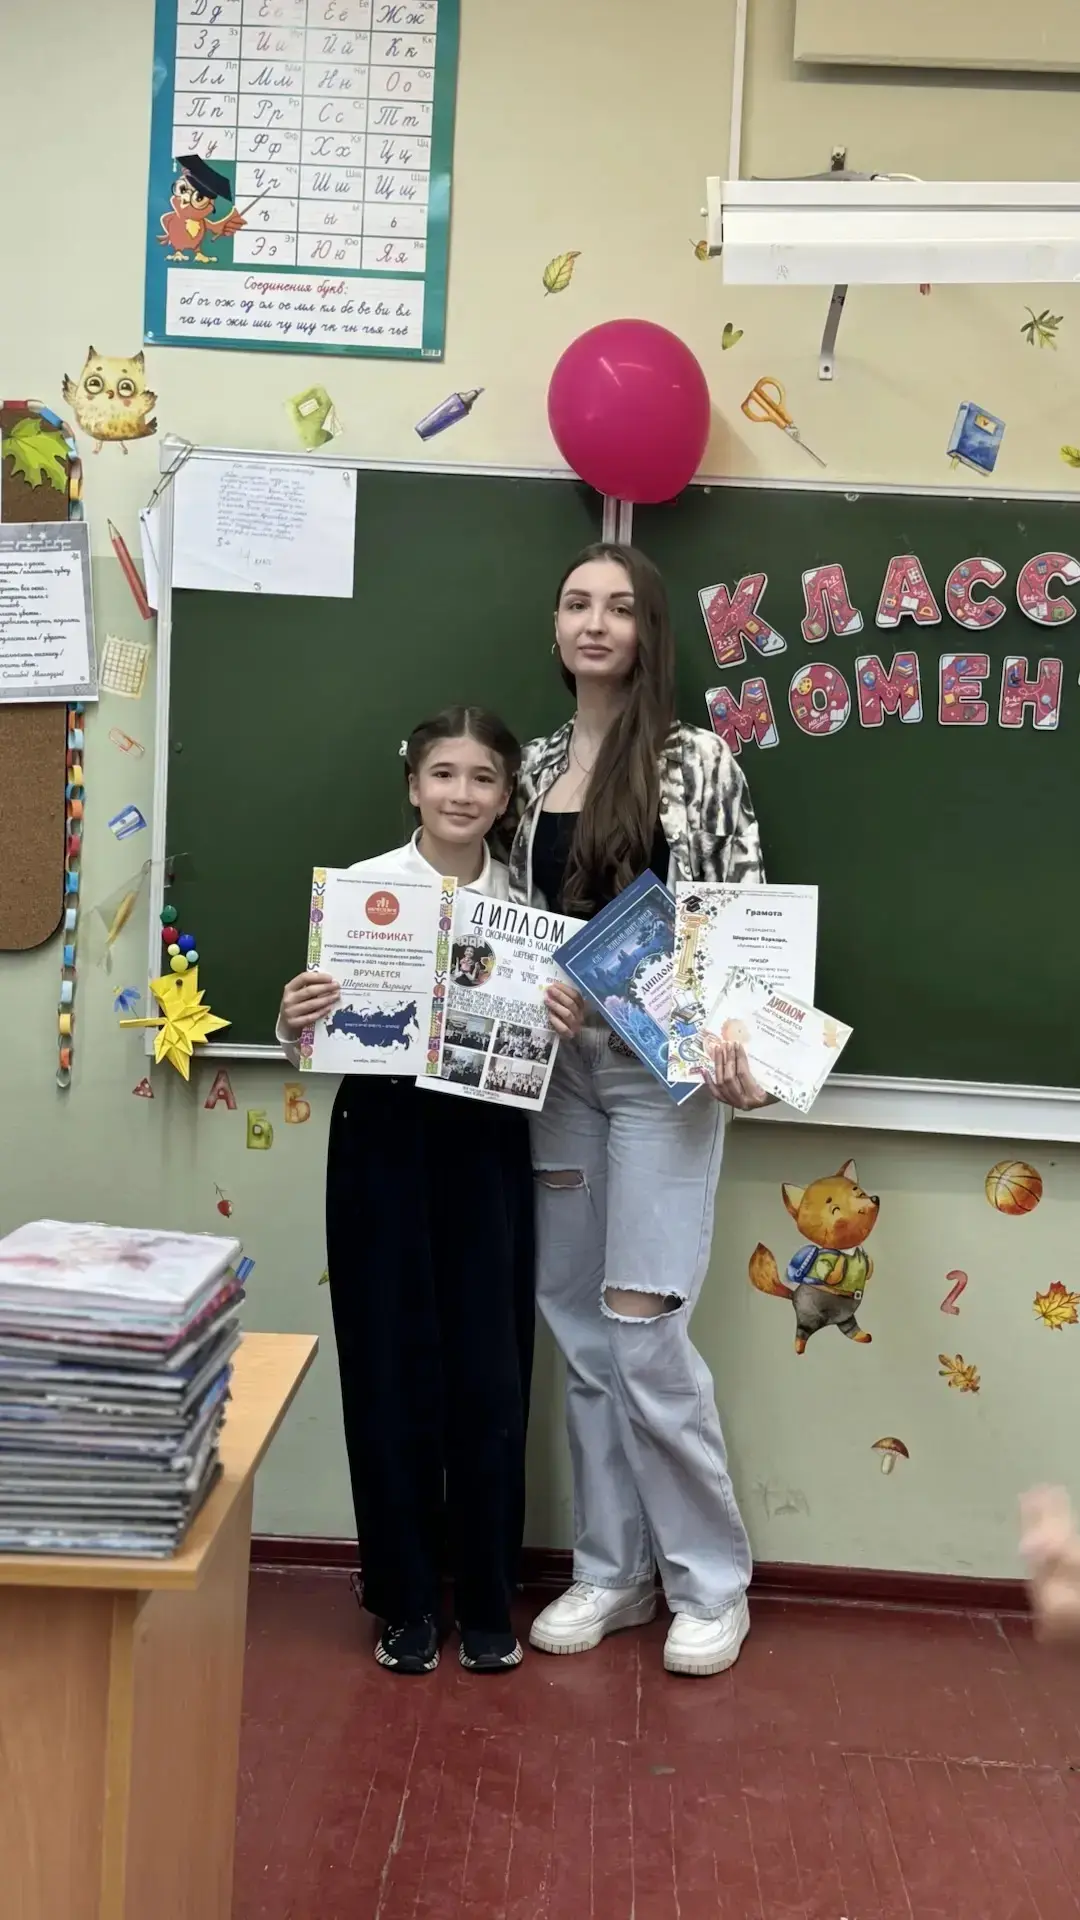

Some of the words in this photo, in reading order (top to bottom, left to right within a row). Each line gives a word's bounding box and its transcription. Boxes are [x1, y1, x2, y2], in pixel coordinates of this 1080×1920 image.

[244, 275, 312, 295] Соединения
[316, 279, 348, 299] букв:
[705, 651, 1080, 756] МОМЕН
[470, 901, 565, 945] ДИПЛОМ
[745, 908, 783, 917] Грамота
[347, 929, 414, 942] СЕРТИФИКАТ
[474, 926, 484, 937] ОБ
[485, 928, 526, 948] ОКОНЧАНИИ
[527, 938, 533, 948] 3
[353, 968, 401, 978] ВРУЧАЕТСЯ
[766, 996, 807, 1024] ДИПЛОМ
[940, 1269, 968, 1316] 2
